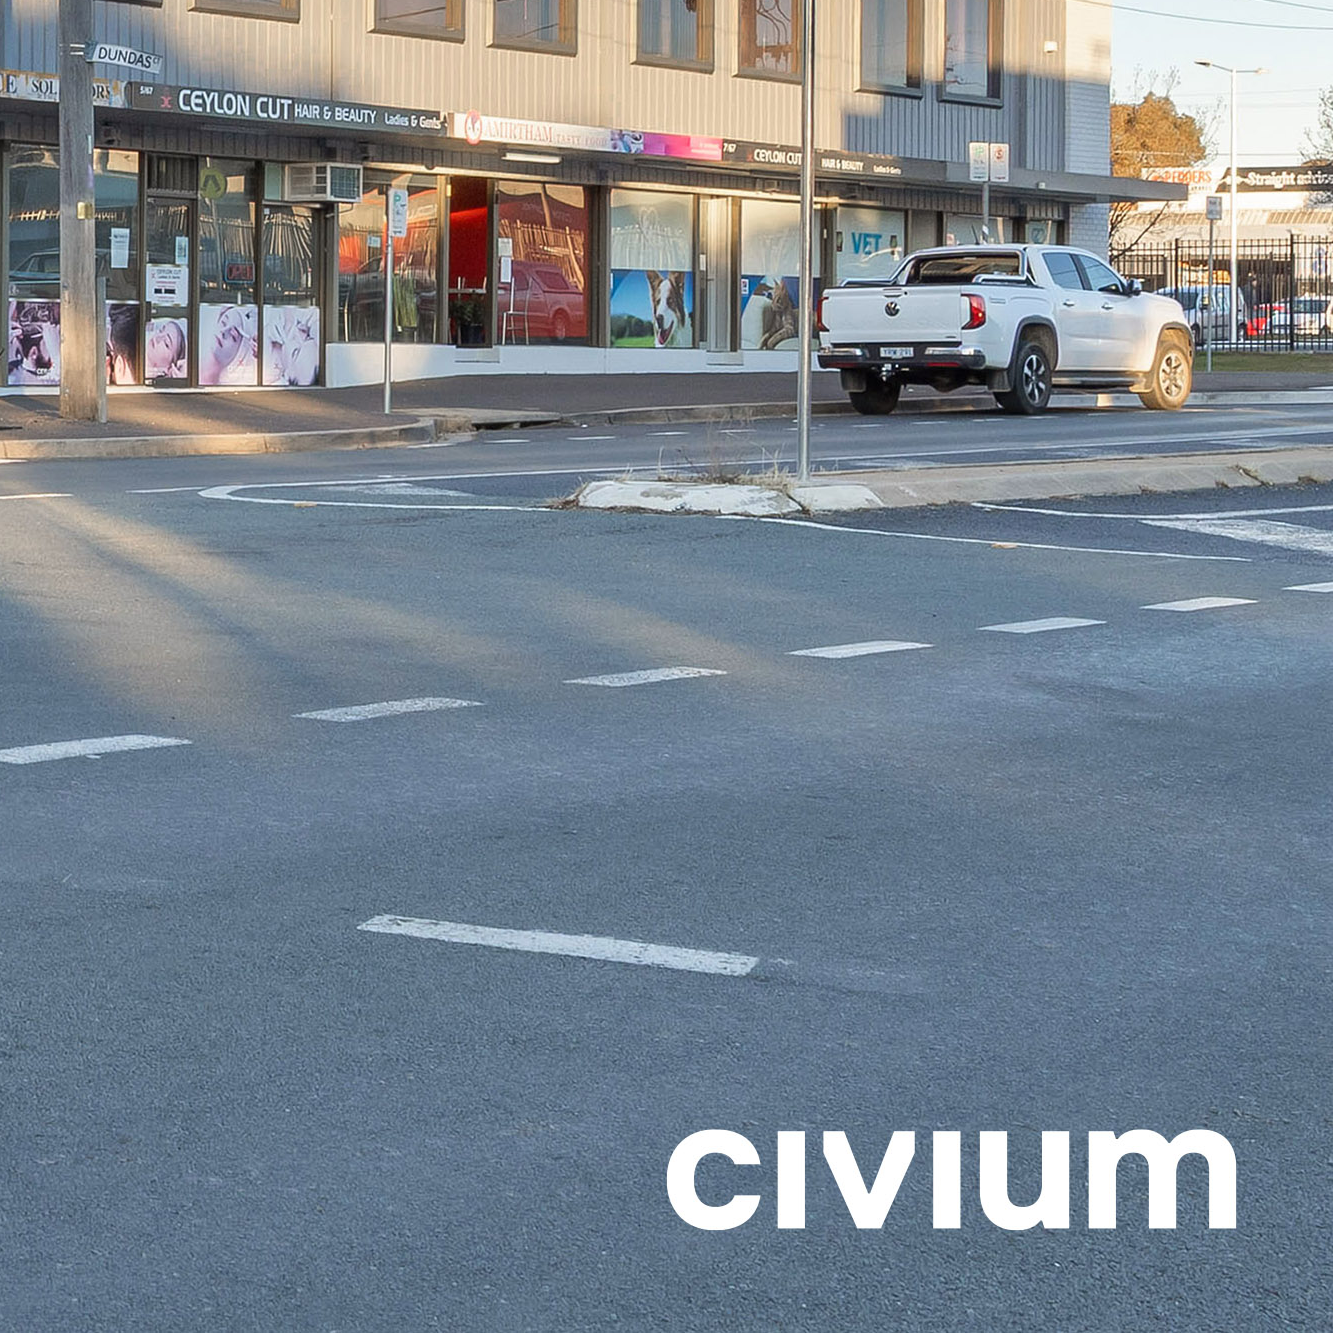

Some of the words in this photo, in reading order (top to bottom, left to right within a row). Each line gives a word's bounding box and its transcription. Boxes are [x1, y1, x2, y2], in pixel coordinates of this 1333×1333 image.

[98, 47, 152, 69] DUNDAS
[179, 90, 250, 116] CEYLON
[256, 97, 293, 120] CUT
[294, 103, 320, 119] HAIR
[323, 107, 332, 120] &
[334, 107, 377, 124] BEAUTY
[385, 112, 409, 127] Ladies
[410, 114, 418, 127] &
[483, 120, 553, 143] AMIRTHAM
[753, 149, 786, 164] CEYLON
[786, 153, 802, 166] CUT
[842, 159, 864, 171] BEAUTY
[1248, 171, 1295, 189] Straight
[851, 232, 883, 256] VET
